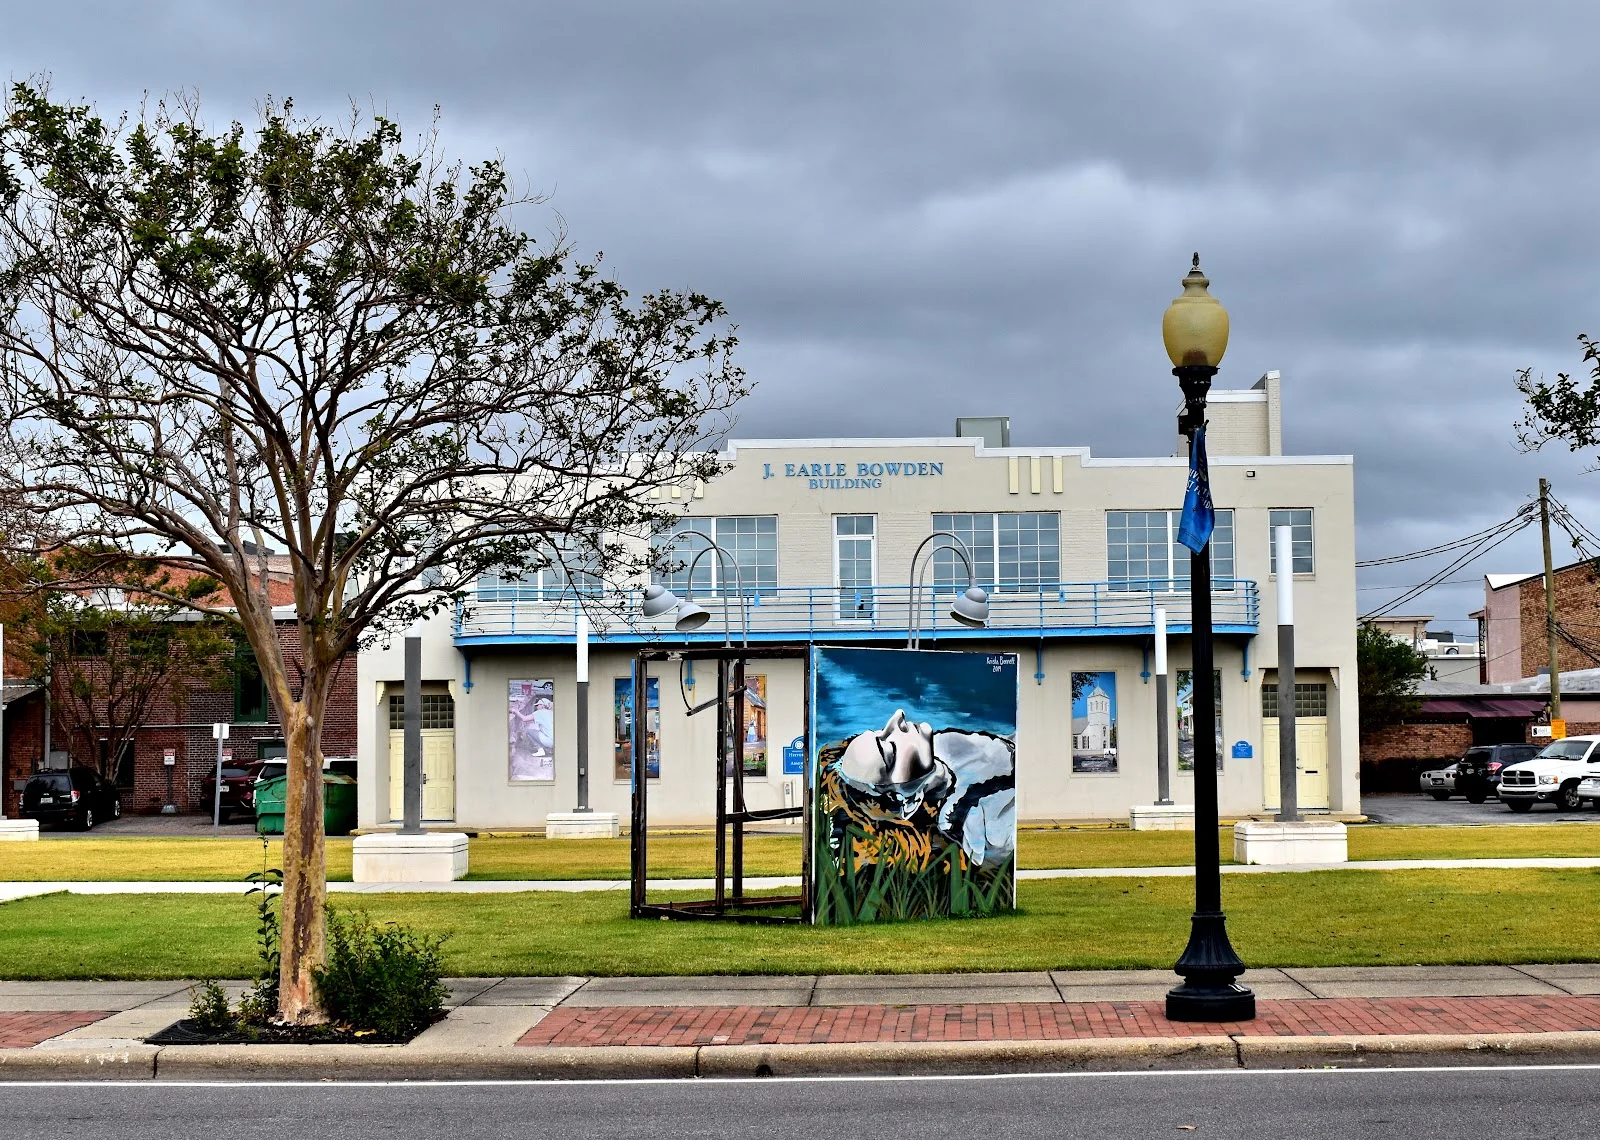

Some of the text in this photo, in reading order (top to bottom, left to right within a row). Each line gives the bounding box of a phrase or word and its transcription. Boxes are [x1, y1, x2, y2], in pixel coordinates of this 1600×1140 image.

[763, 462, 944, 479] J. EARLE BOWDEN
[809, 478, 882, 489] BUILDING
